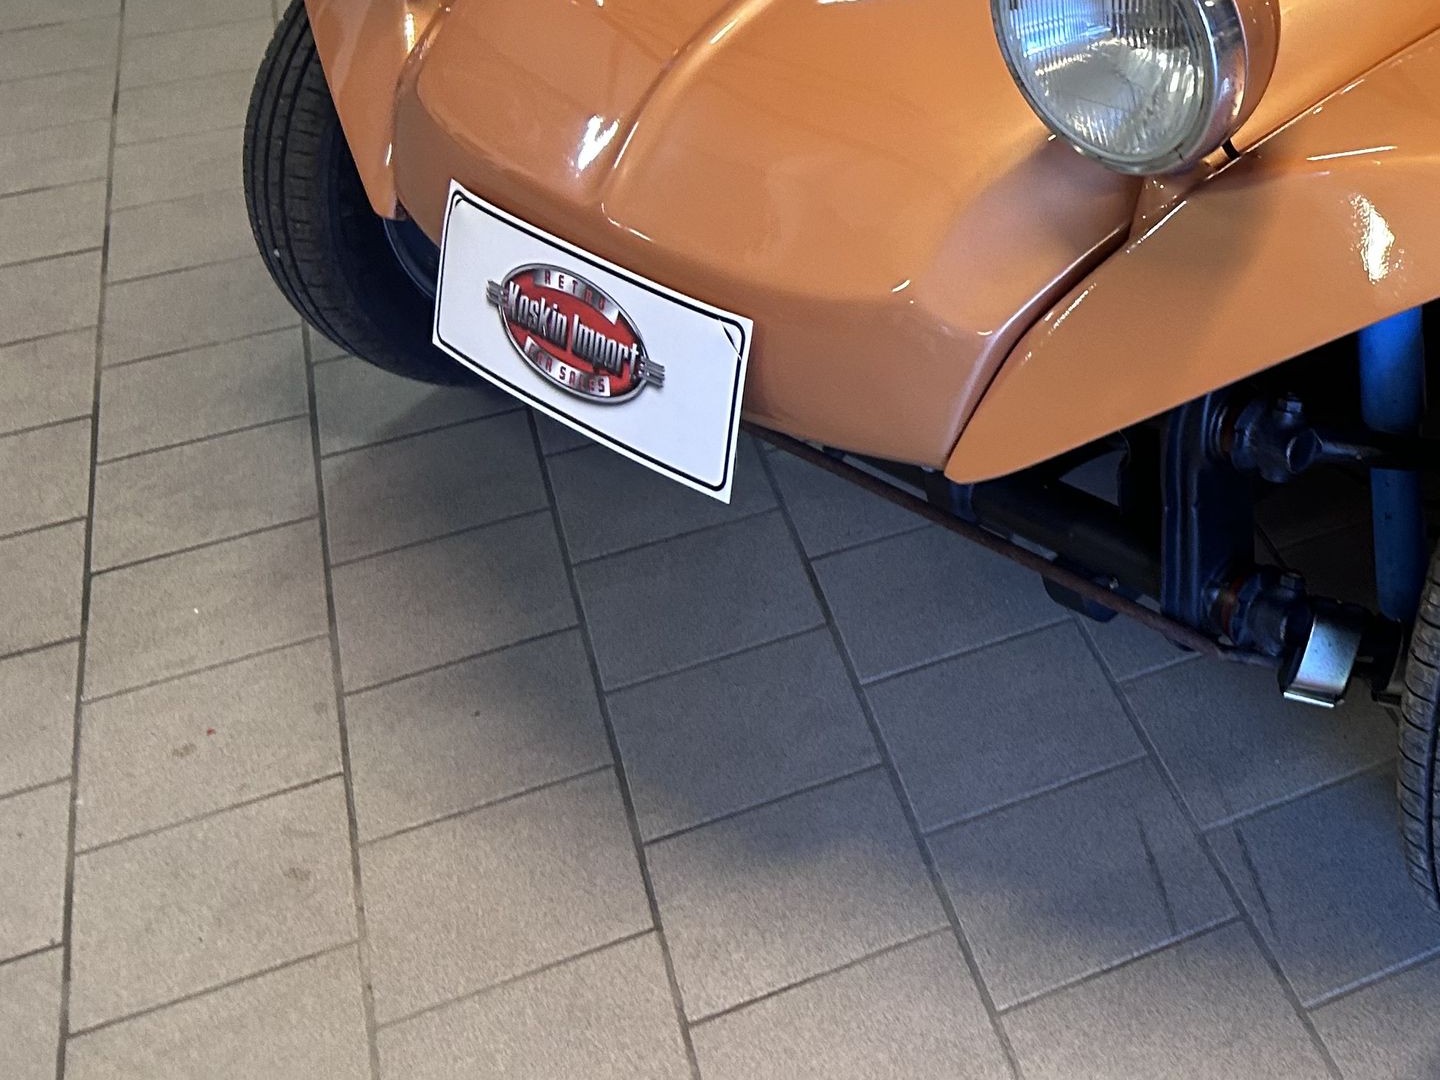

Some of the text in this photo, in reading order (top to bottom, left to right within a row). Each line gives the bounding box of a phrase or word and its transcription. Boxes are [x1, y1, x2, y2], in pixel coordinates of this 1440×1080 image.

[543, 274, 607, 311] RETRO
[508, 281, 640, 376] Koskin Import
[558, 366, 606, 393] SALES
